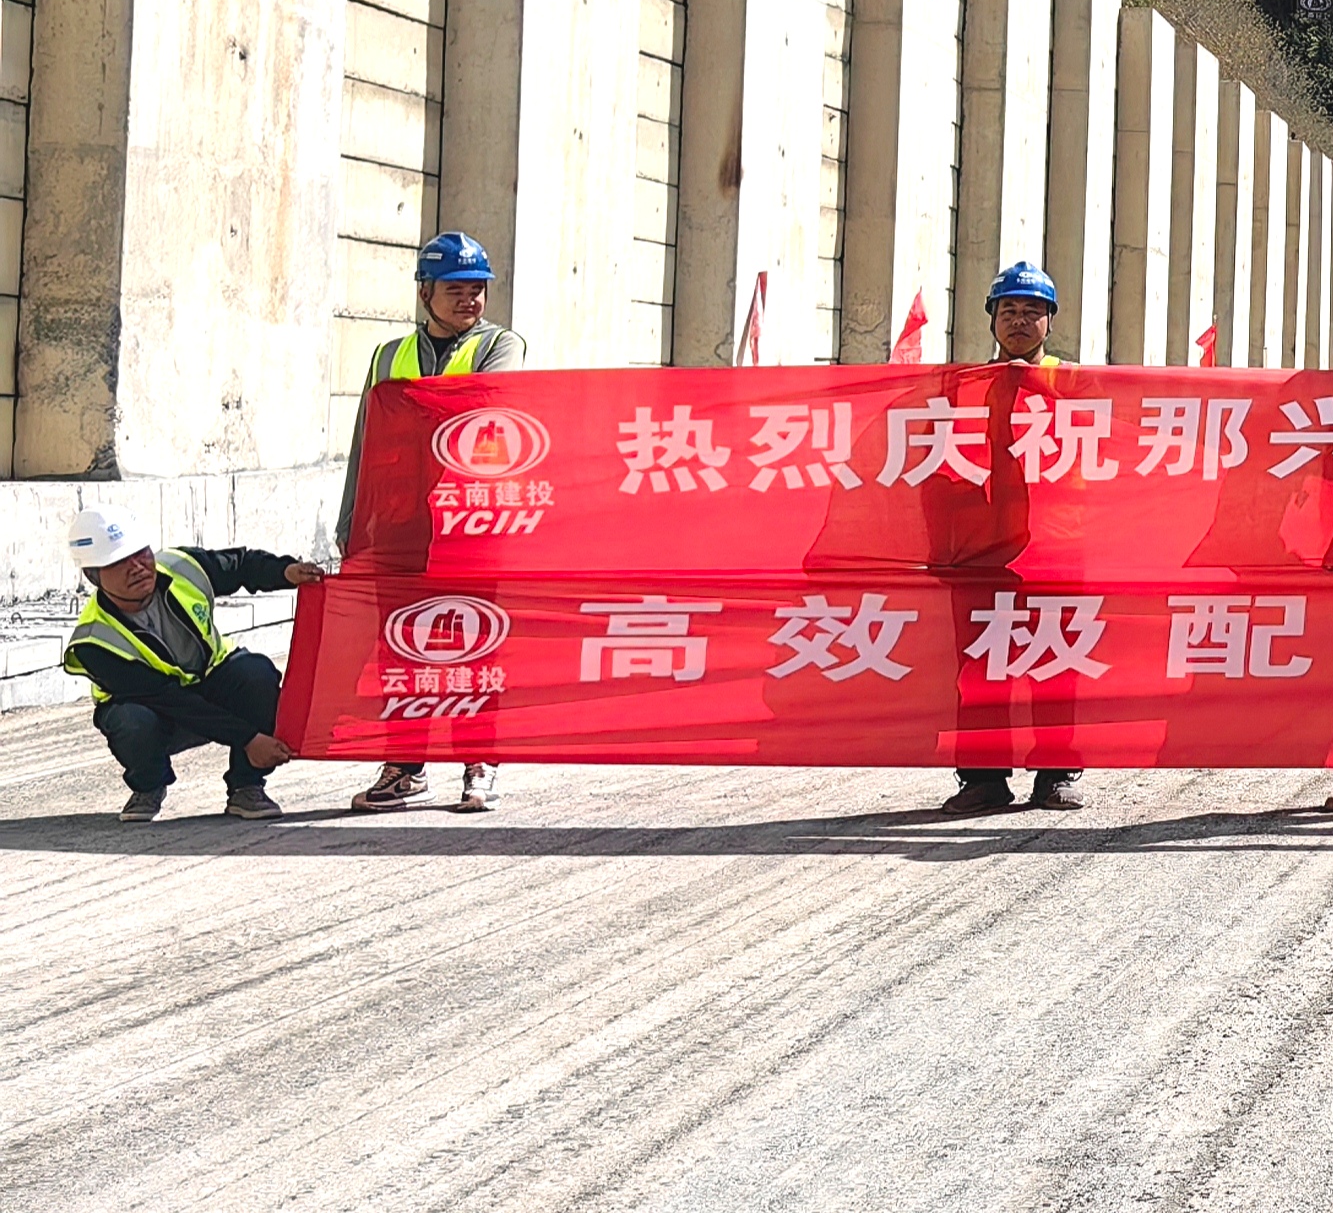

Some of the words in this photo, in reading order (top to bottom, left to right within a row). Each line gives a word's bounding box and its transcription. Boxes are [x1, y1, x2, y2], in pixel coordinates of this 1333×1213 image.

[433, 481, 554, 507] 云南建投
[440, 510, 545, 535] YCIH
[380, 666, 507, 694] 云南建投
[379, 695, 490, 720] YCIH
